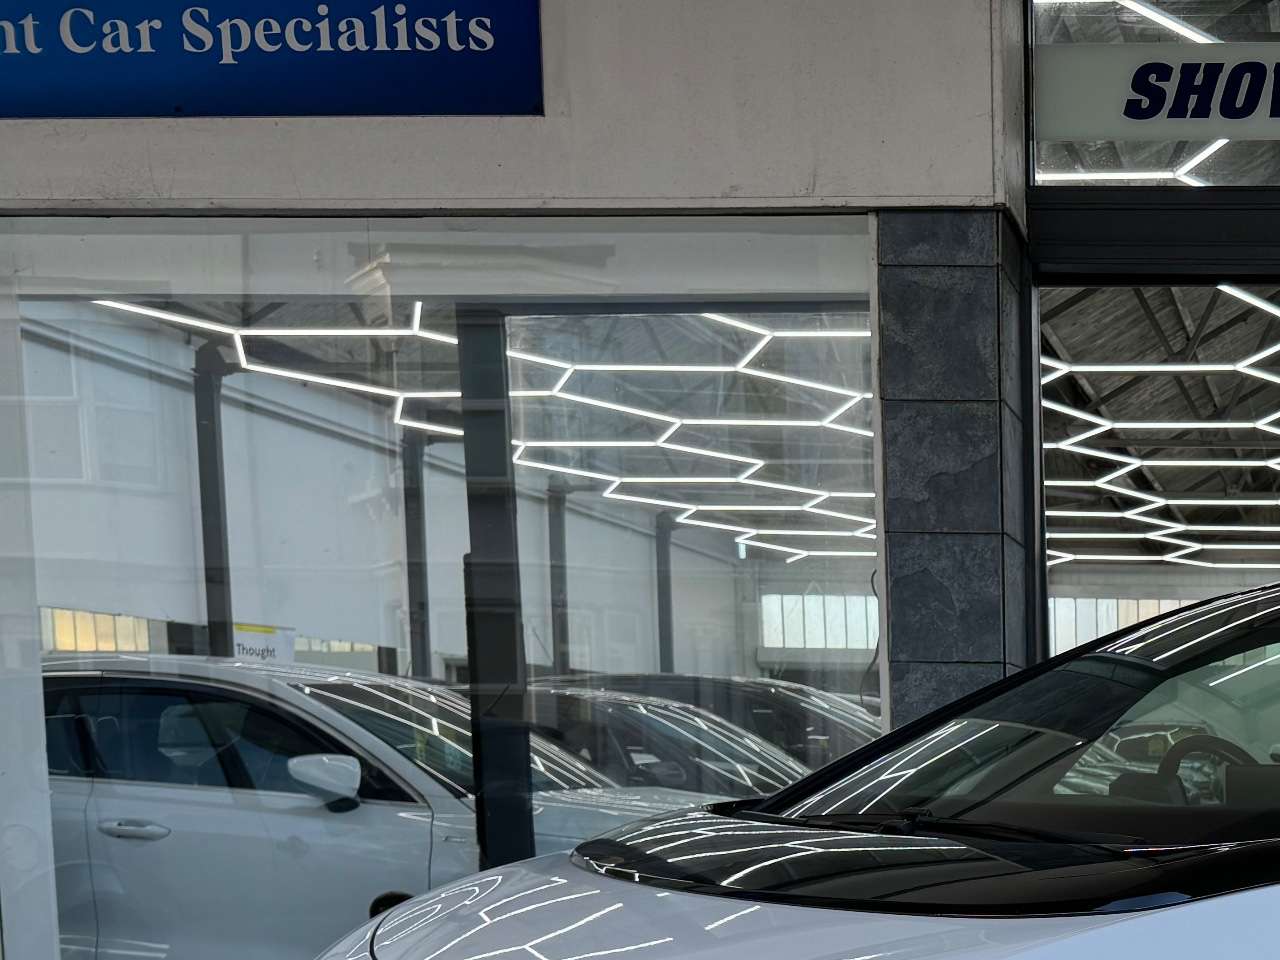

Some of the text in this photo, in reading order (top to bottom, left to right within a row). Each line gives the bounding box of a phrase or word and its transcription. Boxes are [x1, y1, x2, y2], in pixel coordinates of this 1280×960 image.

[59, 7, 163, 54] Car
[181, 4, 496, 65] Specialists
[236, 642, 277, 661] Thought
